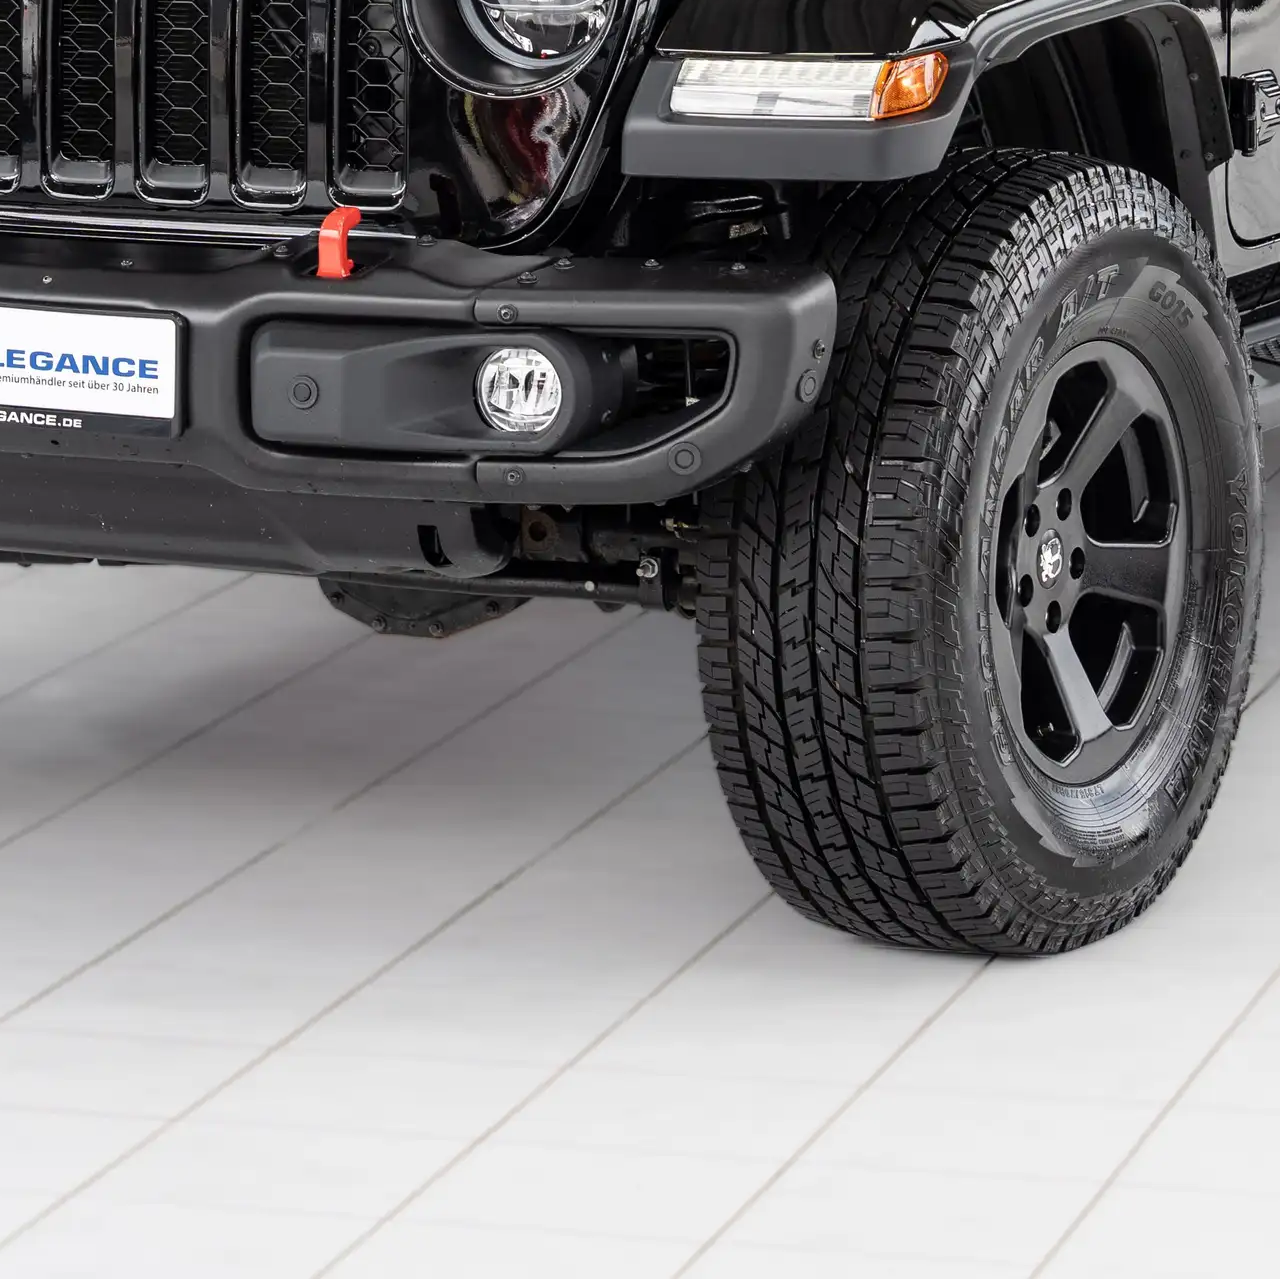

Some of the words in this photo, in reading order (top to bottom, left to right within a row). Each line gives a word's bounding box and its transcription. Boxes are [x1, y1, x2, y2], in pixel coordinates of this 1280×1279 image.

[1148, 280, 1195, 328] G015
[68, 379, 85, 389] seit
[87, 380, 110, 391] über
[112, 382, 125, 392] 30
[126, 383, 160, 395] Jahren
[1165, 467, 1249, 812] YOKOHAMA
